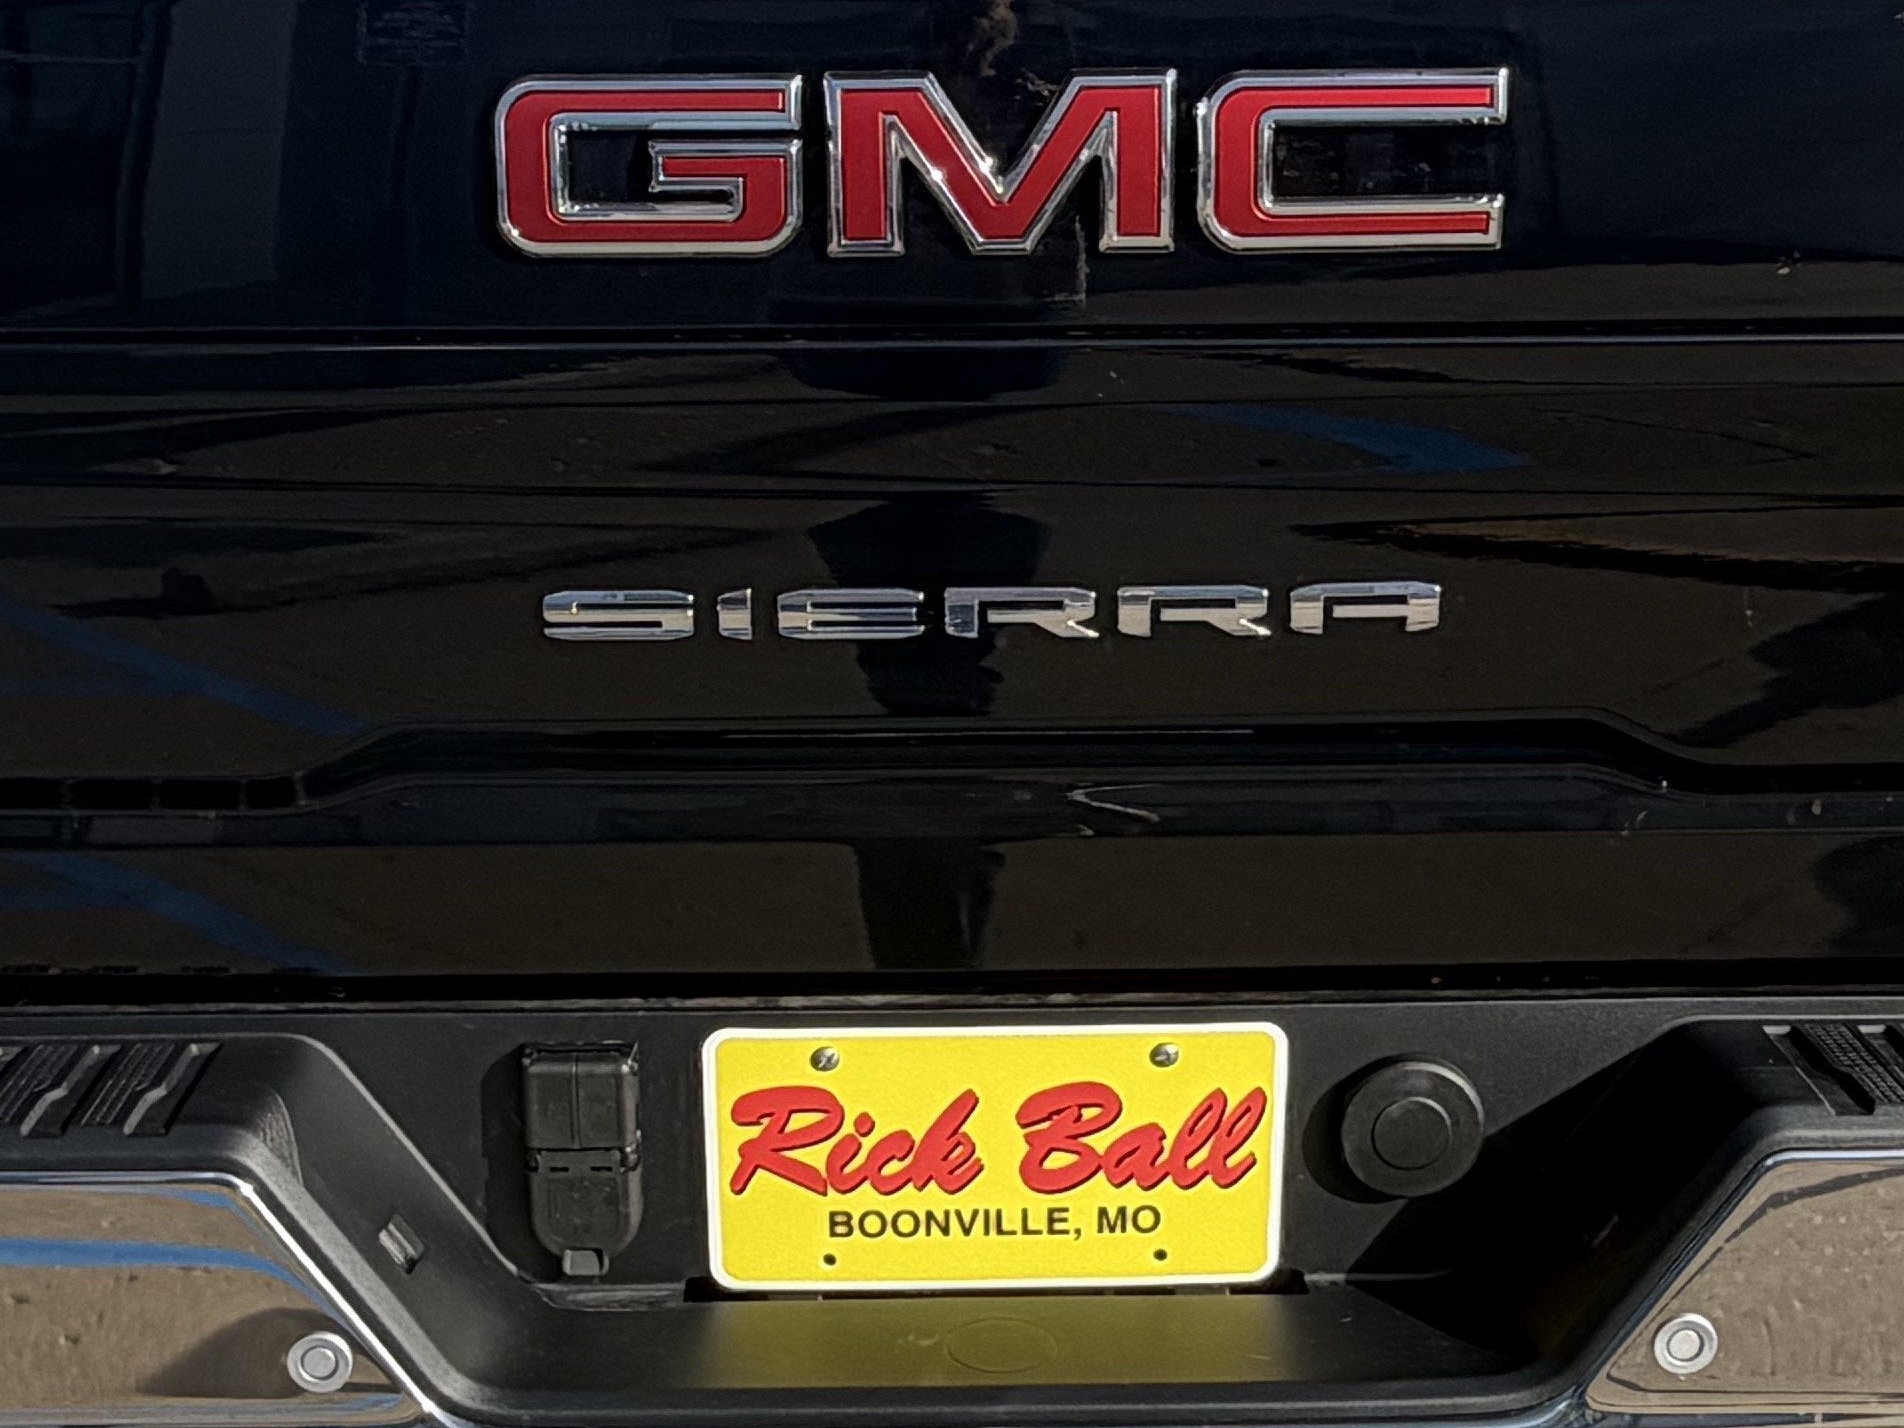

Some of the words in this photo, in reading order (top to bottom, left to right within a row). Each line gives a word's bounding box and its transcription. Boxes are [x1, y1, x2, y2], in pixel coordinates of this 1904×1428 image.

[496, 67, 1510, 258] GMC
[542, 581, 1442, 641] SIERRA
[729, 1084, 985, 1197] Rick
[1015, 1080, 1268, 1195] Ball
[828, 1207, 1083, 1240] BOONVILLE,
[1097, 1205, 1161, 1235] MO
